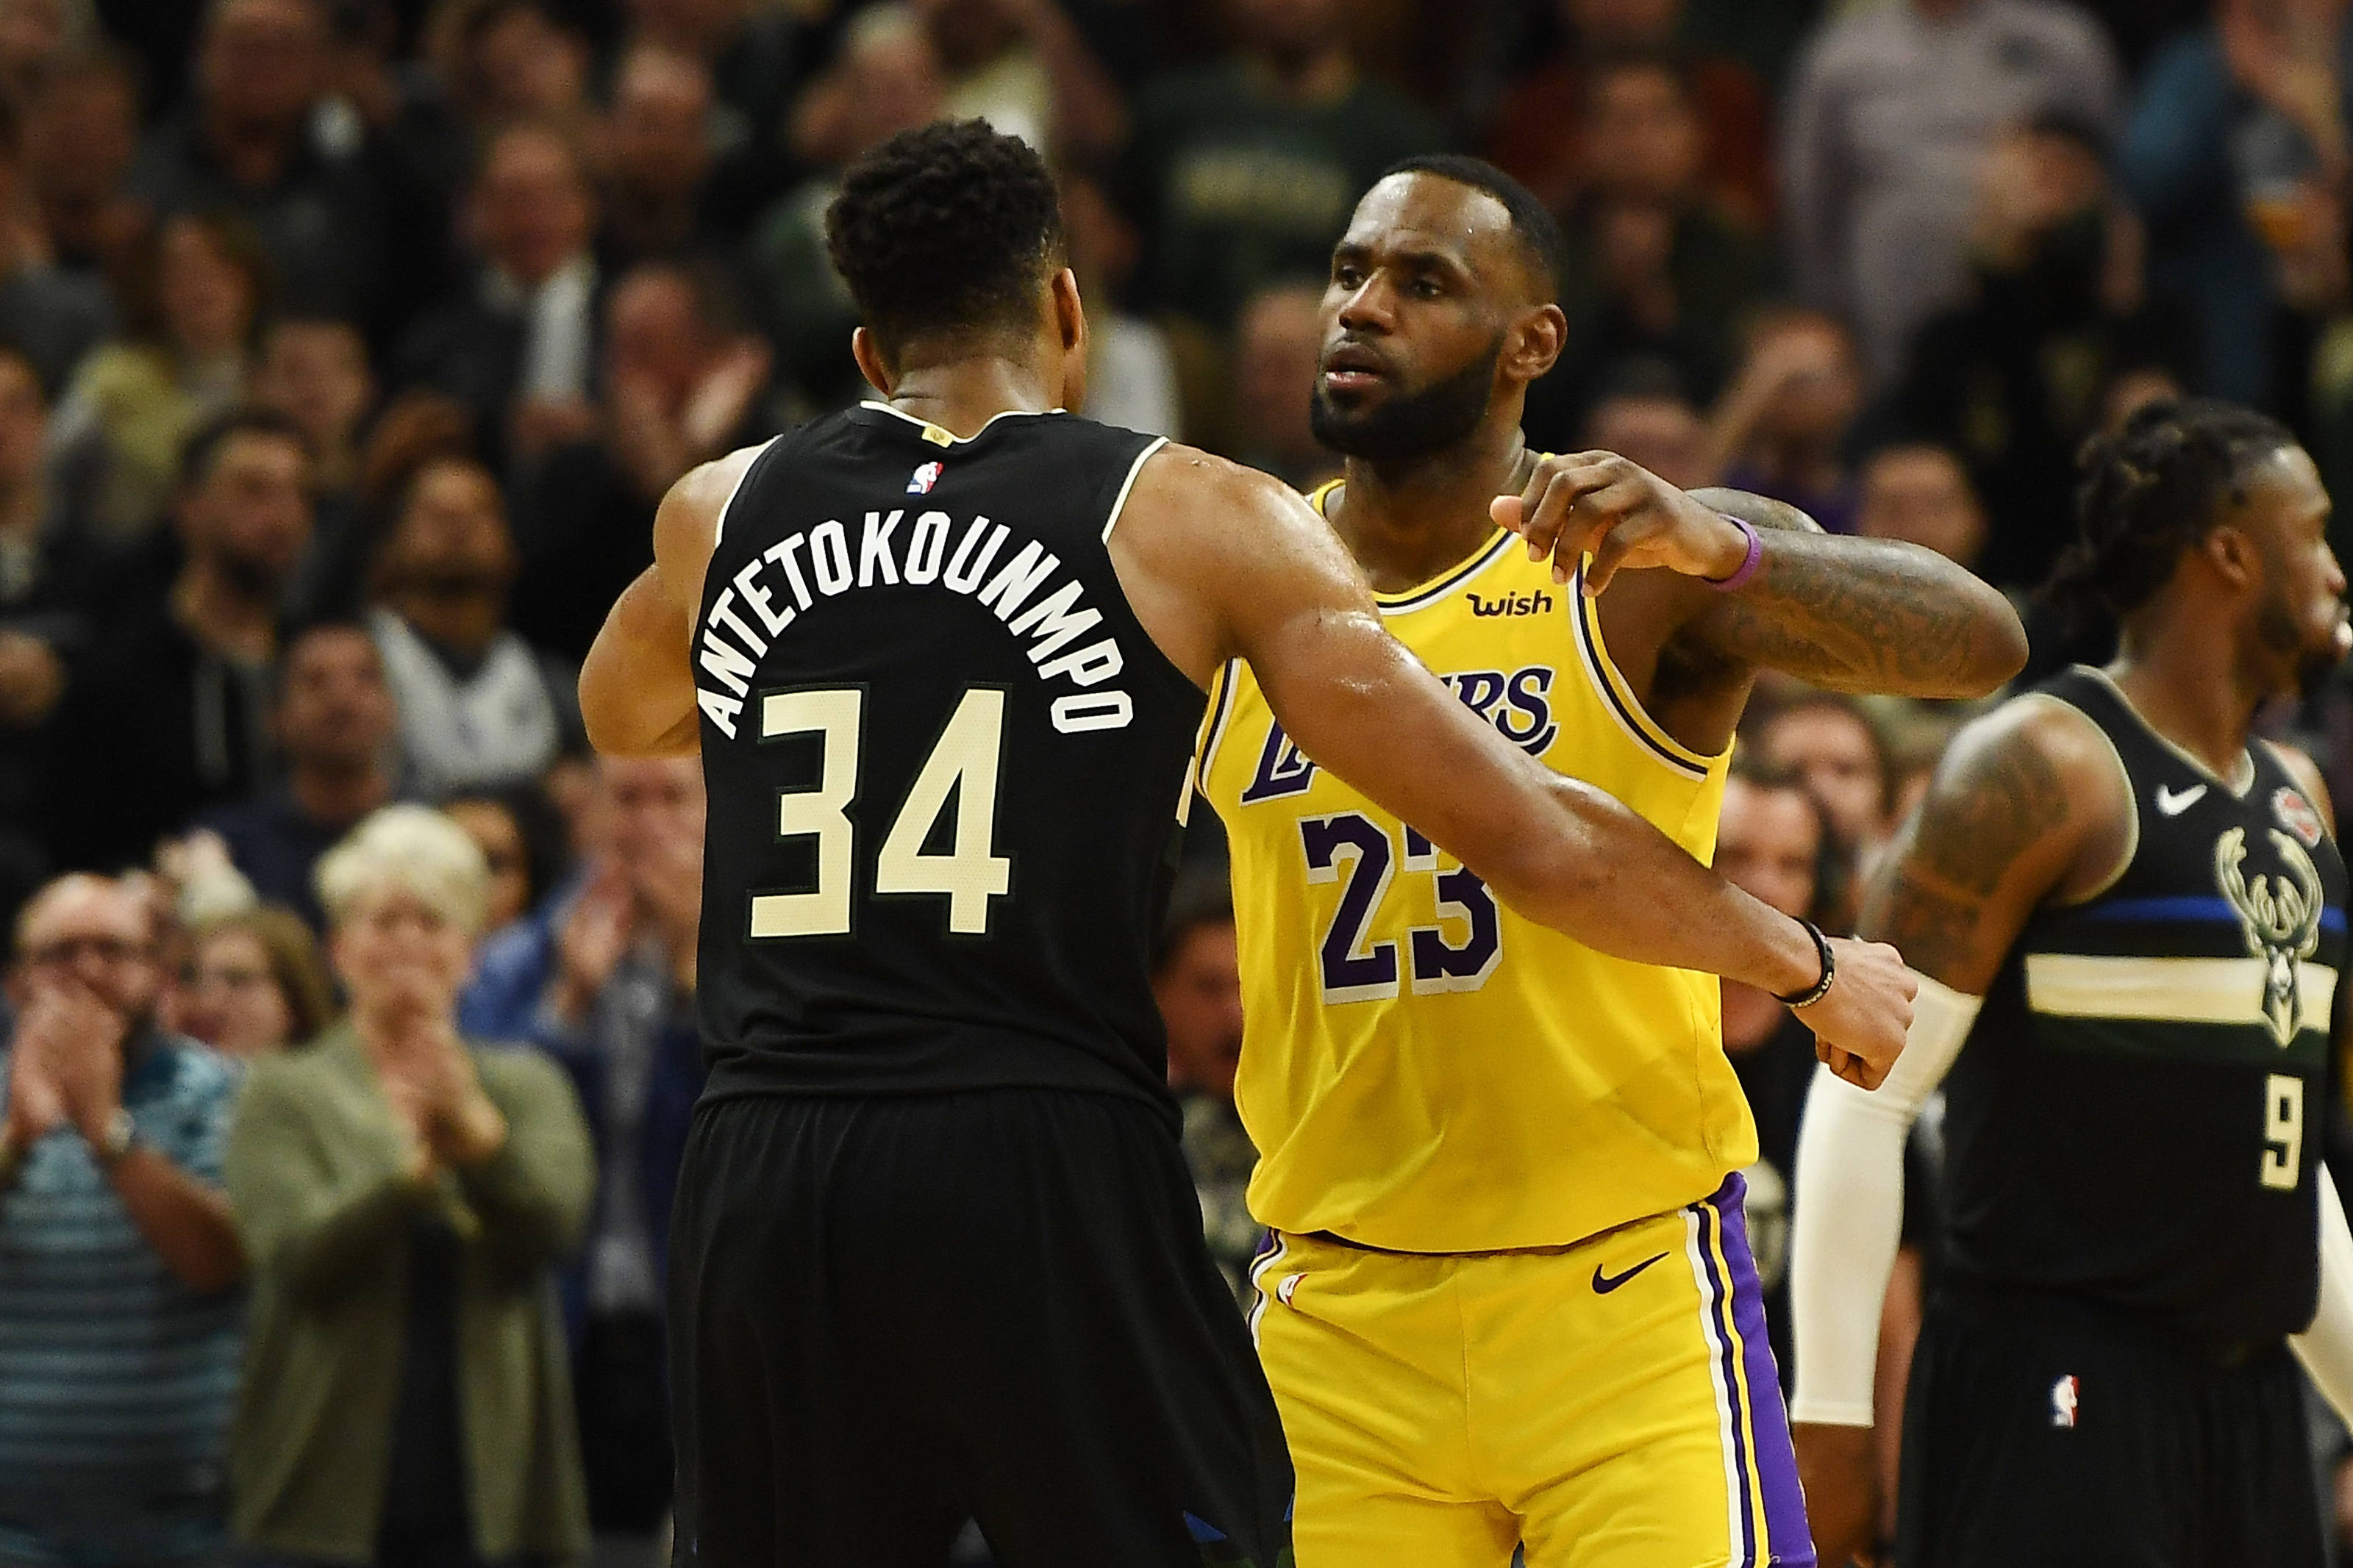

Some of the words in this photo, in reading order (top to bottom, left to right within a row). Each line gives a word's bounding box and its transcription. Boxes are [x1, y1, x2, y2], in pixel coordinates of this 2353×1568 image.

[696, 509, 1134, 740] ANTETOKOUNMPO
[1465, 590, 1553, 616] wish
[749, 689, 1010, 938] 34
[1240, 665, 1560, 806] LRS
[1296, 810, 1504, 1006] 23
[2260, 1073, 2304, 1191] 9
